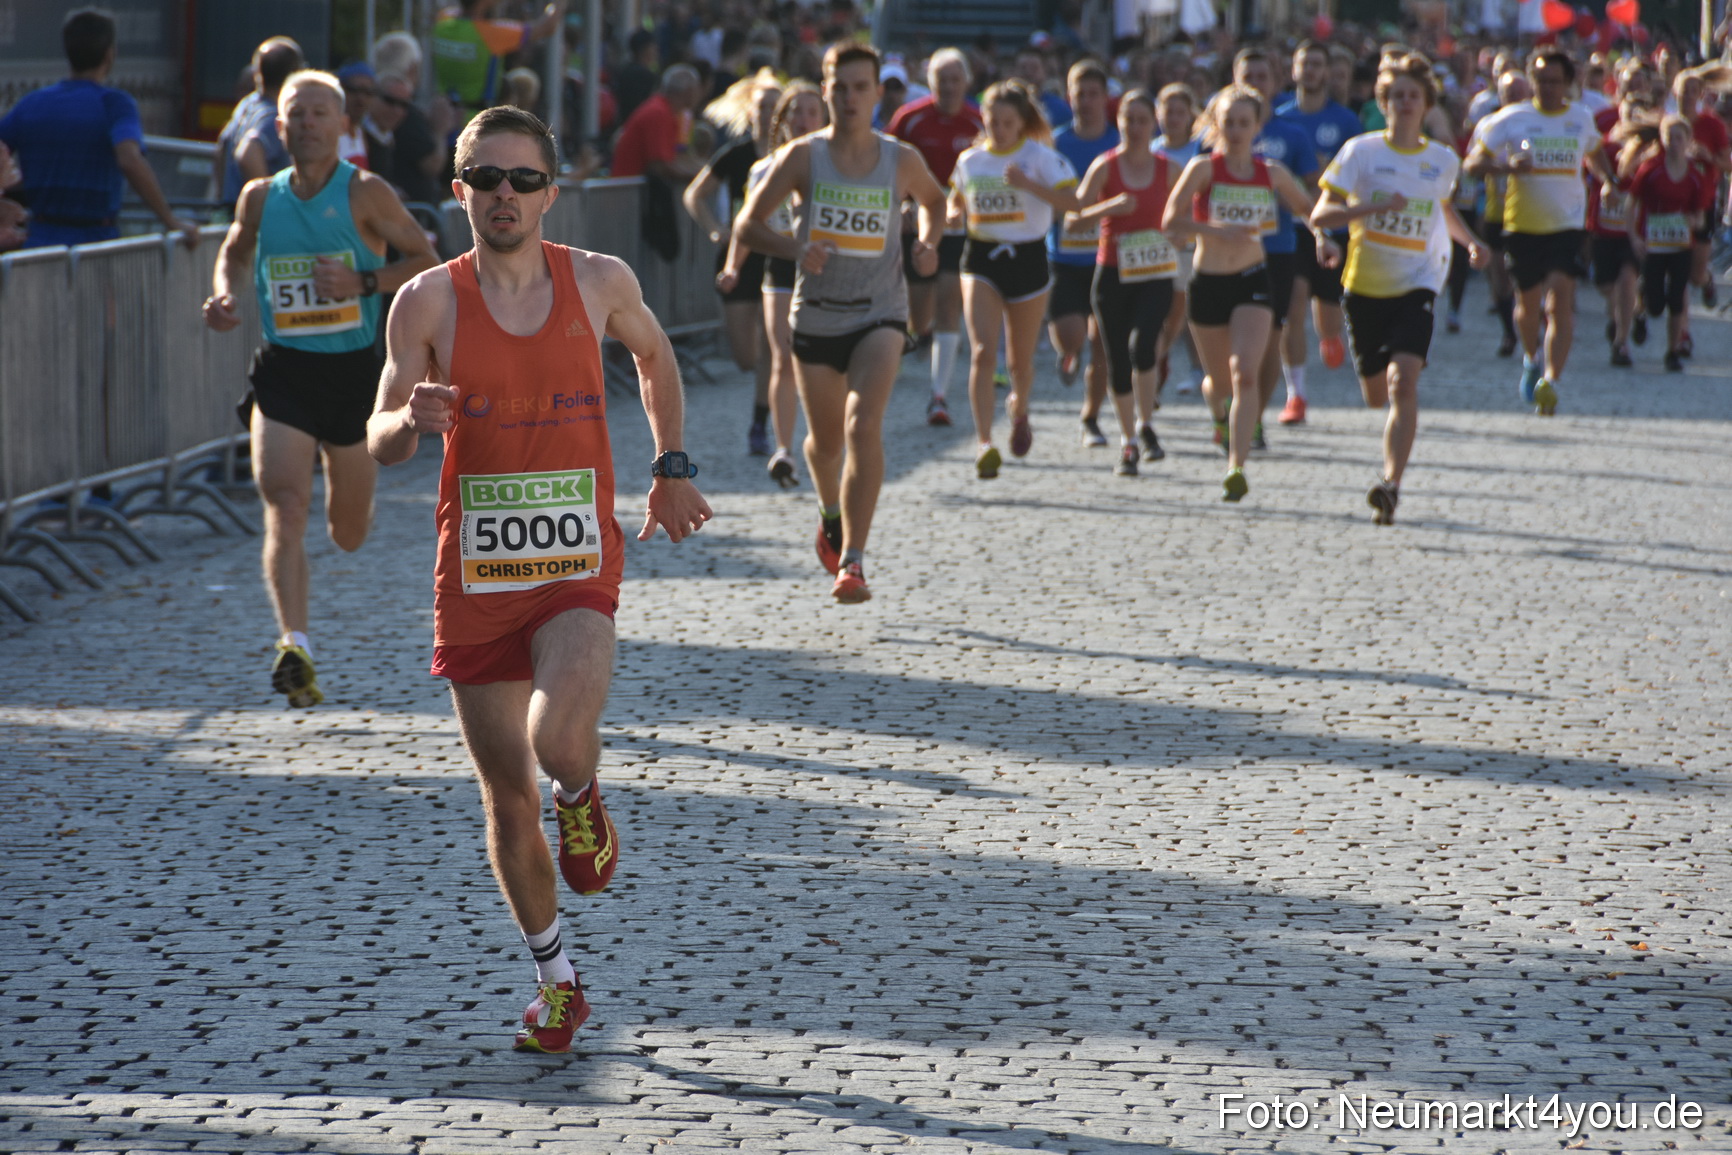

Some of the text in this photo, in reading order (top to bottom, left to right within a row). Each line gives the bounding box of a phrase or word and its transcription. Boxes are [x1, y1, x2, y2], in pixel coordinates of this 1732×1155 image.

[821, 187, 882, 203] BOCK
[819, 207, 880, 232] 5266
[469, 475, 584, 507] BOCK
[476, 513, 585, 552] 5000
[476, 558, 586, 578] CHRISTOPH
